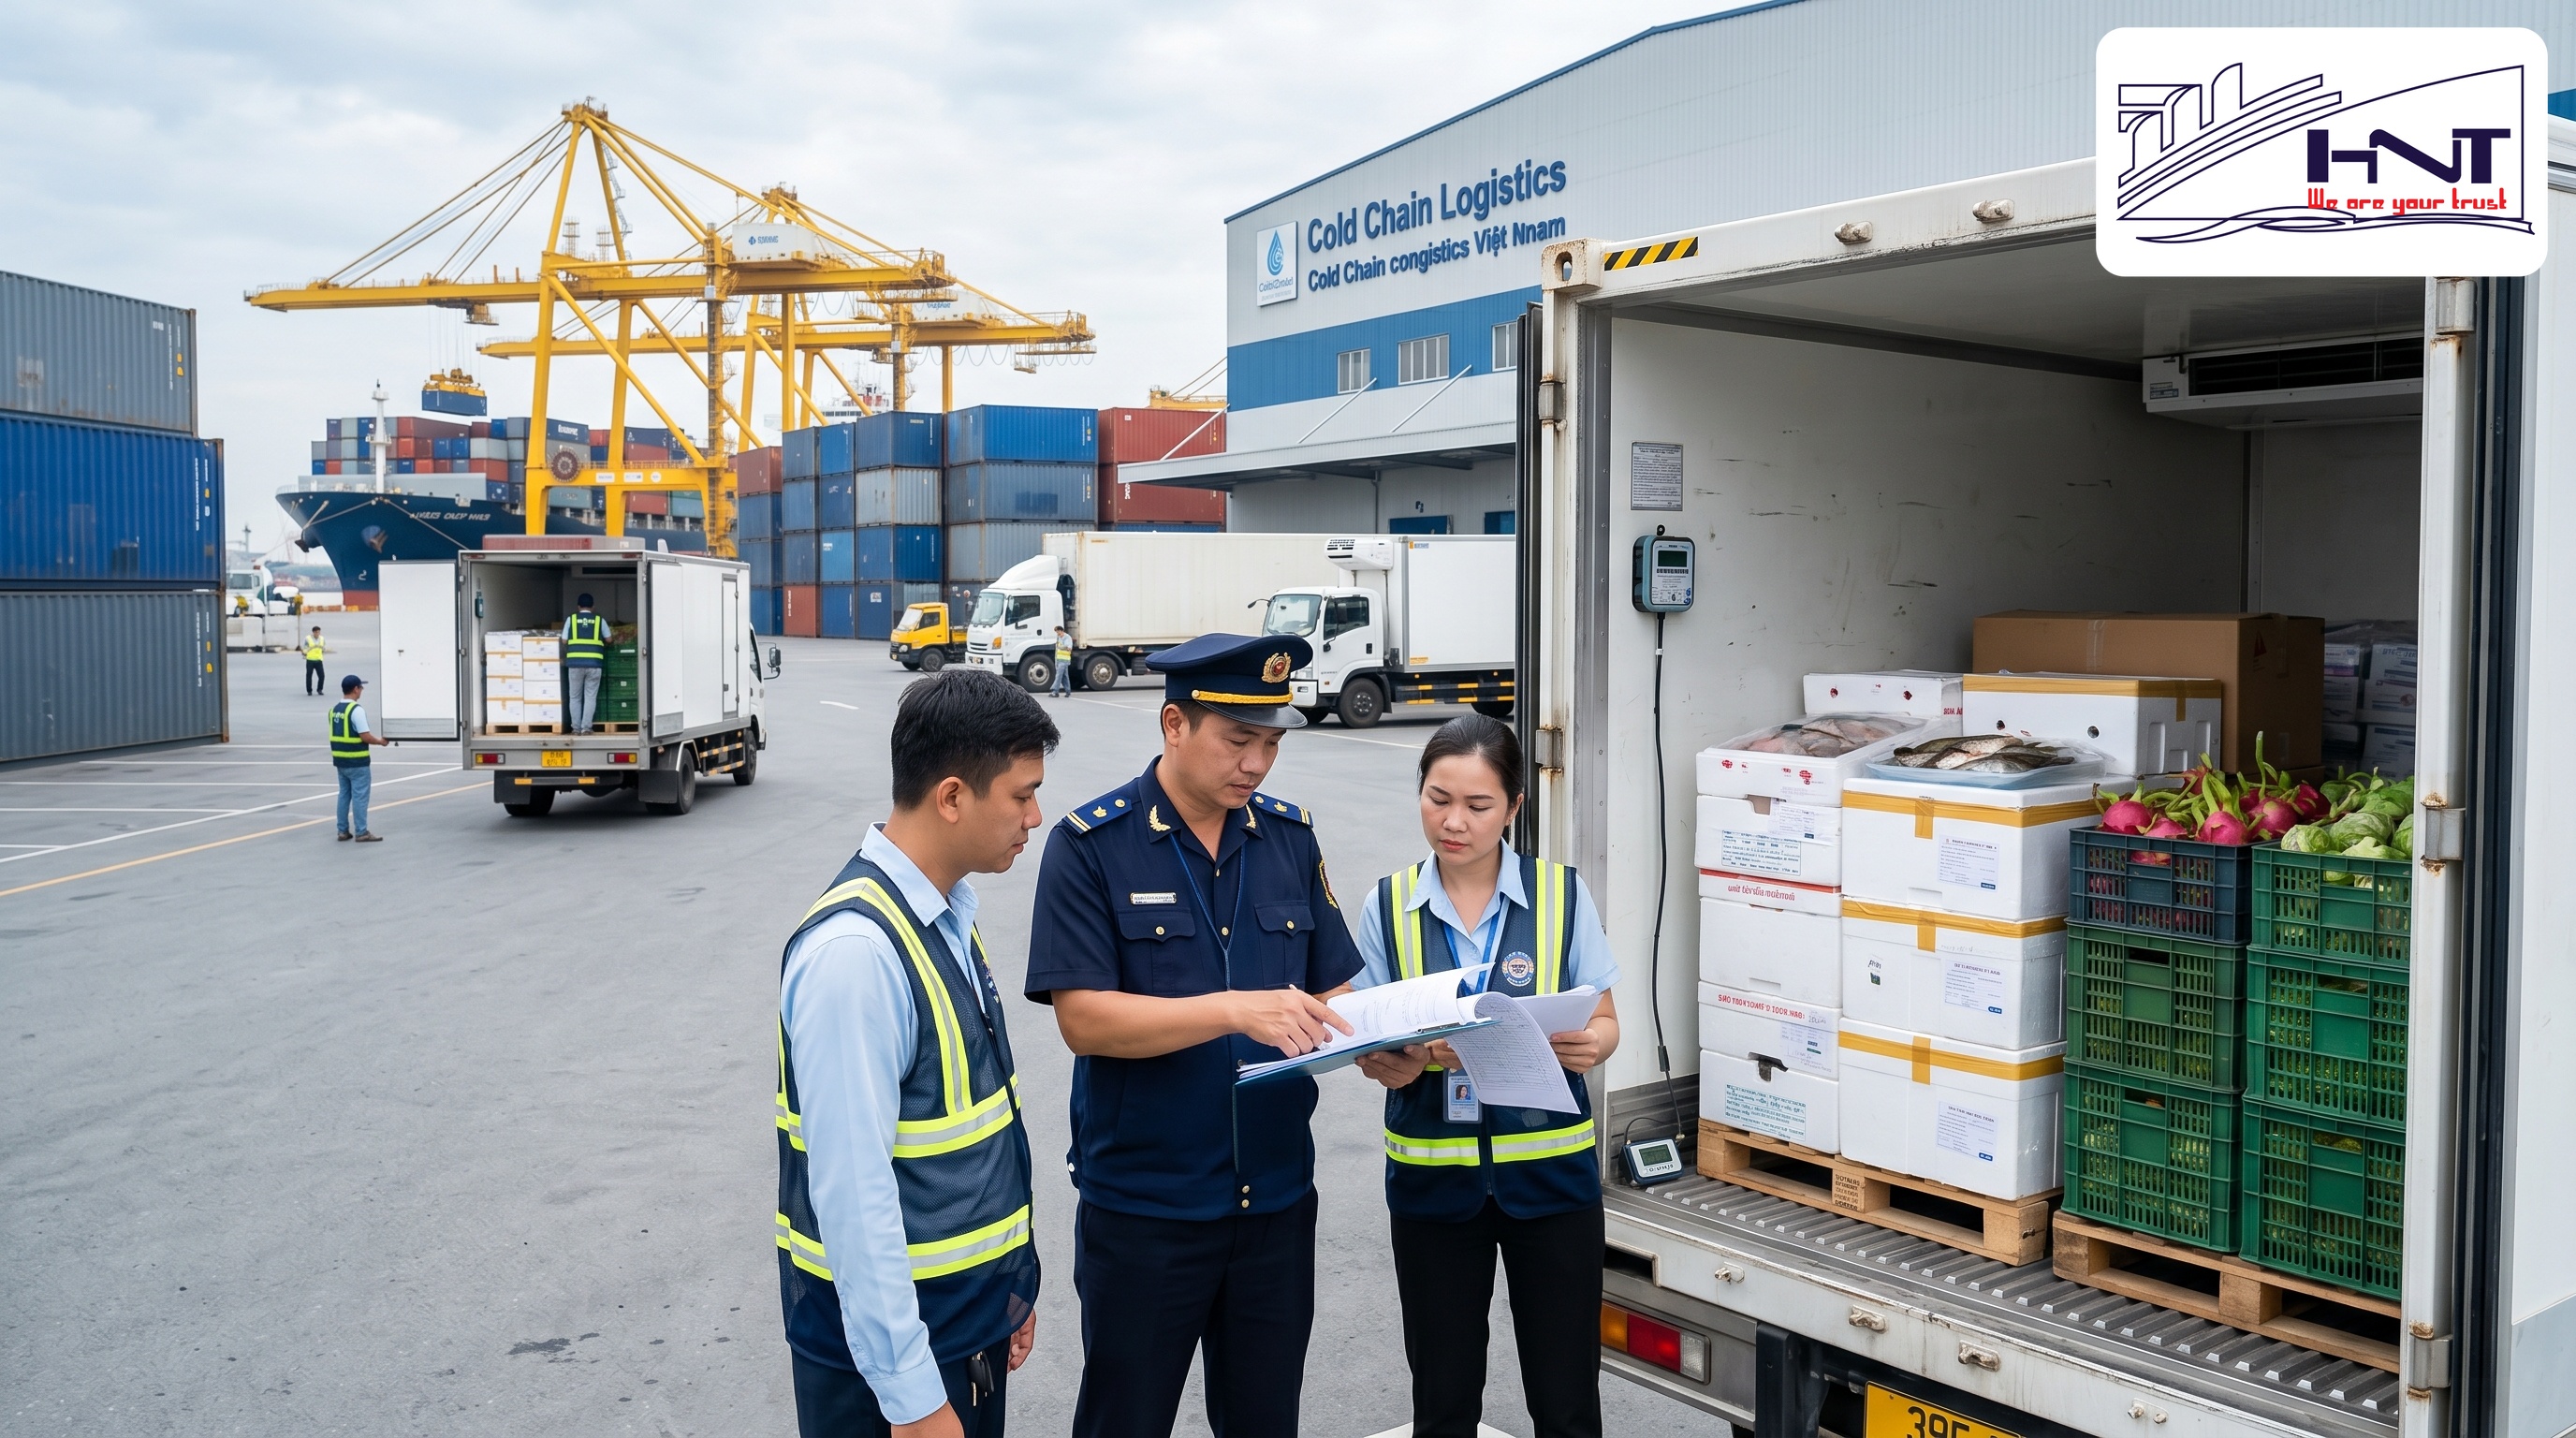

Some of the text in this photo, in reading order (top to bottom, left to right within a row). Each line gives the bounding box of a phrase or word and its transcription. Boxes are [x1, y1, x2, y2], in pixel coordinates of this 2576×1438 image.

[1308, 159, 1567, 254] Cold Chain Logistics
[1308, 263, 1340, 292] Cold
[1343, 255, 1386, 285] Chain
[1389, 237, 1471, 274] congistics
[1512, 216, 1566, 247] Nnam
